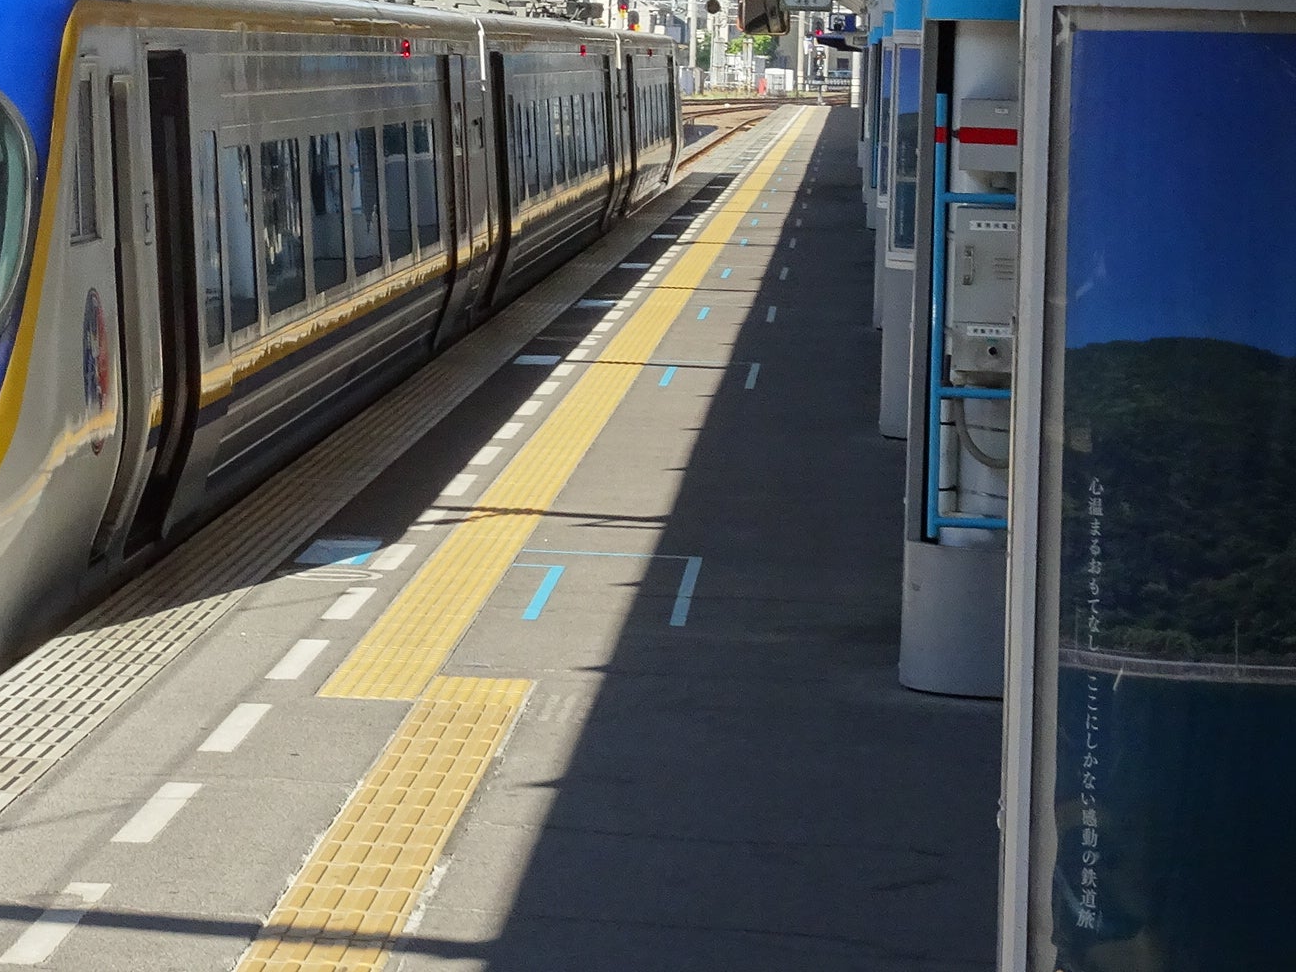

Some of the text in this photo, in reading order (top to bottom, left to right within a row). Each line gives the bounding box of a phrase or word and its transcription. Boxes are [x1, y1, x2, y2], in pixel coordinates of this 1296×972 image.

[1076, 477, 1104, 928] 心温まるおもてなし ここにしかない感動の鉄道旅
